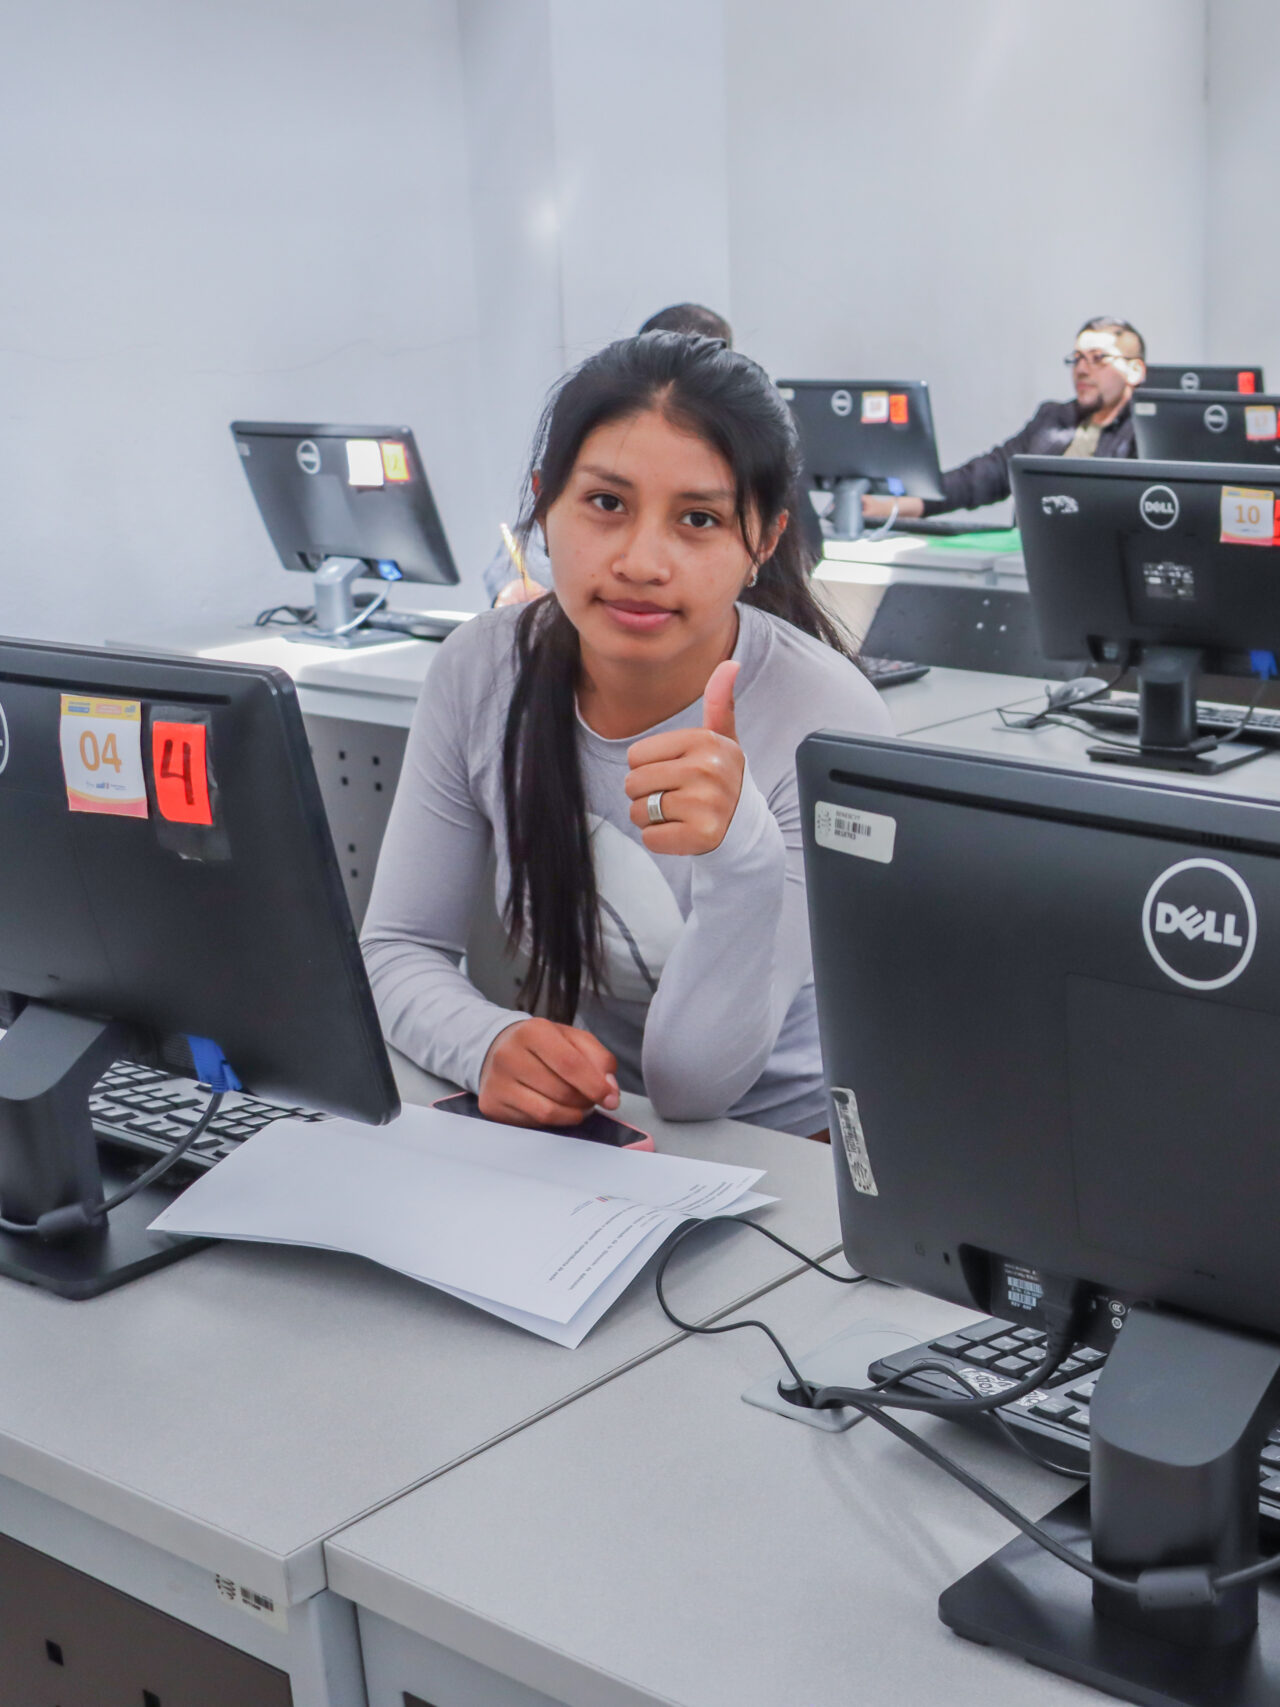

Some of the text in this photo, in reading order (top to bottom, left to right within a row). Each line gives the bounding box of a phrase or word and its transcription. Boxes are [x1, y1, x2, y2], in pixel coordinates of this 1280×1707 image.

[1145, 501, 1175, 514] DELL
[1235, 504, 1260, 525] 10
[80, 730, 122, 774] 04
[160, 739, 195, 806] 4
[1155, 901, 1243, 948] DELL
